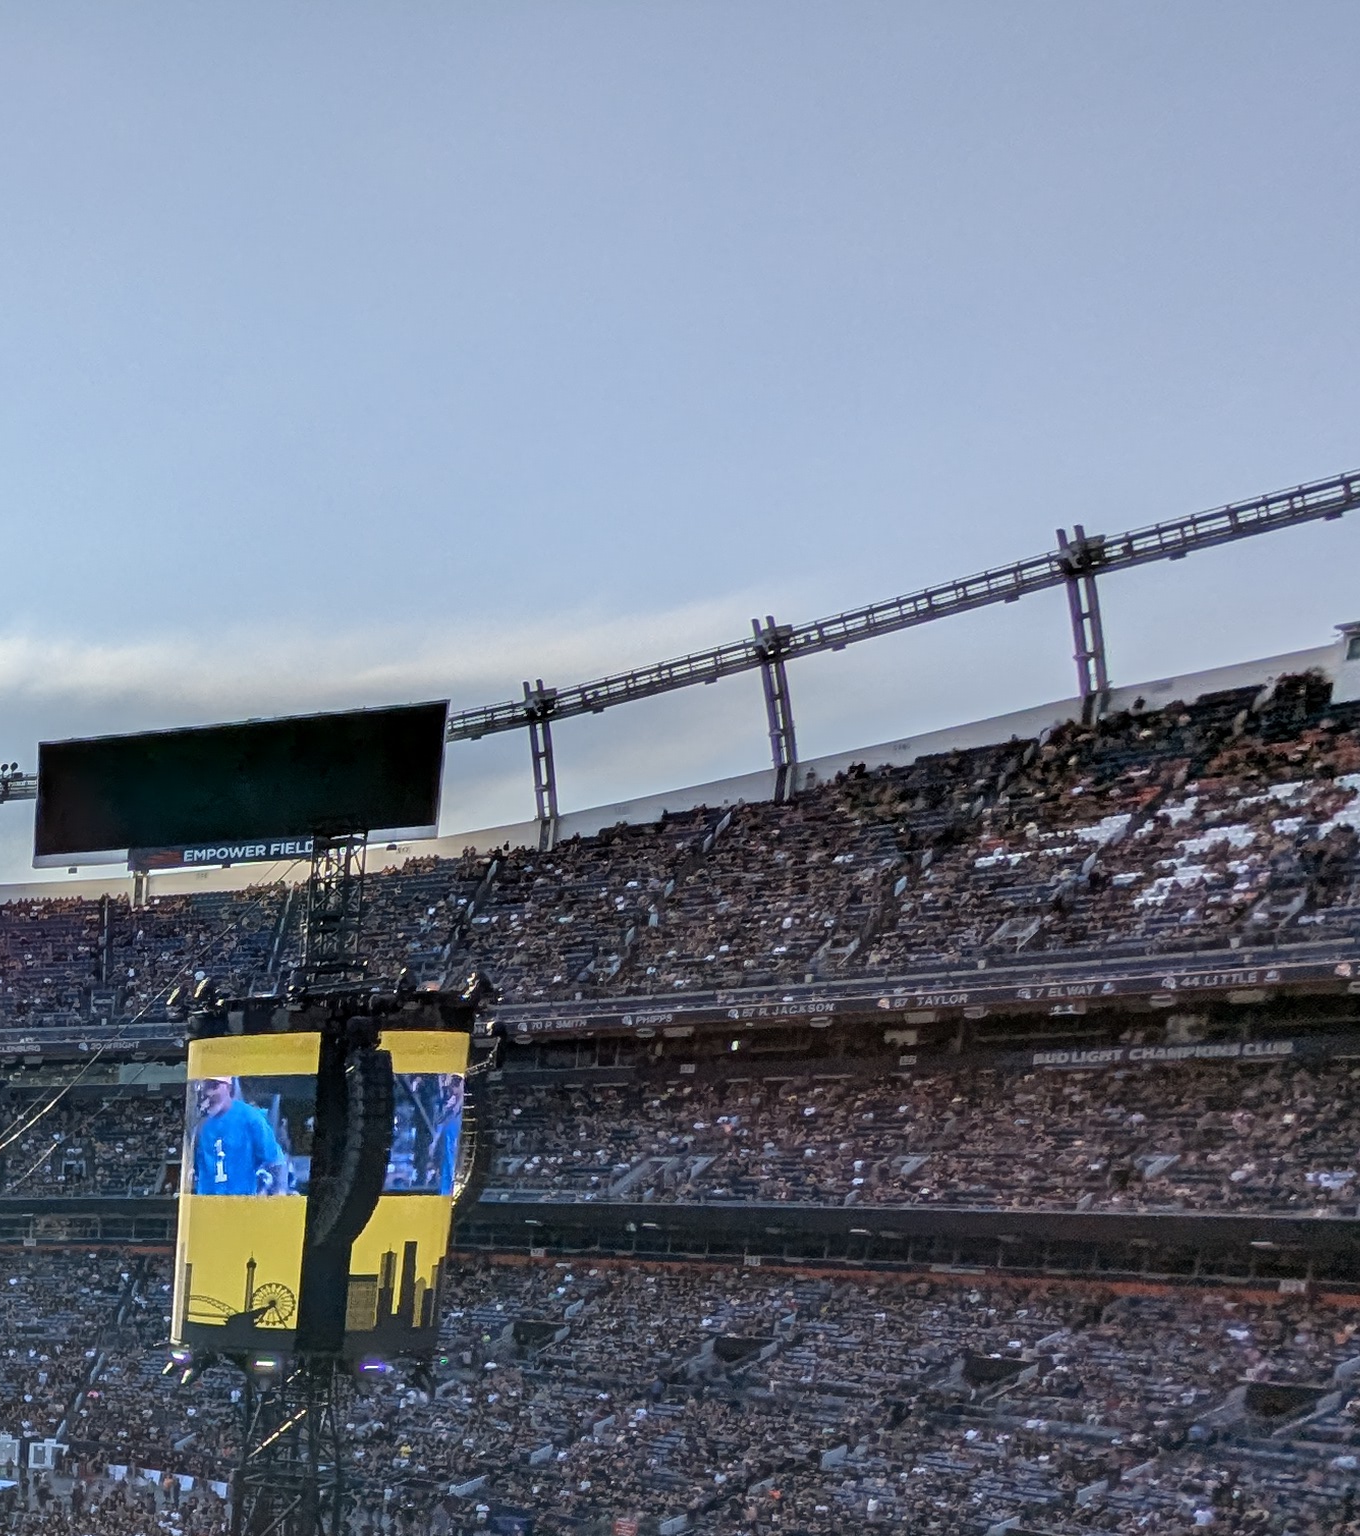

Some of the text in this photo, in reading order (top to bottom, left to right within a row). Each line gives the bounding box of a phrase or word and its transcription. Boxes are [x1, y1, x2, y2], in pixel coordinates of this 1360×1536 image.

[183, 840, 313, 863] EMPOWER FIELD
[1180, 971, 1258, 986] 44 LITTLE
[1036, 983, 1096, 997] 7 ELWAY
[915, 993, 969, 1006] TAYLOR
[771, 1003, 835, 1015] JACKSON
[556, 1019, 588, 1029] SMITH
